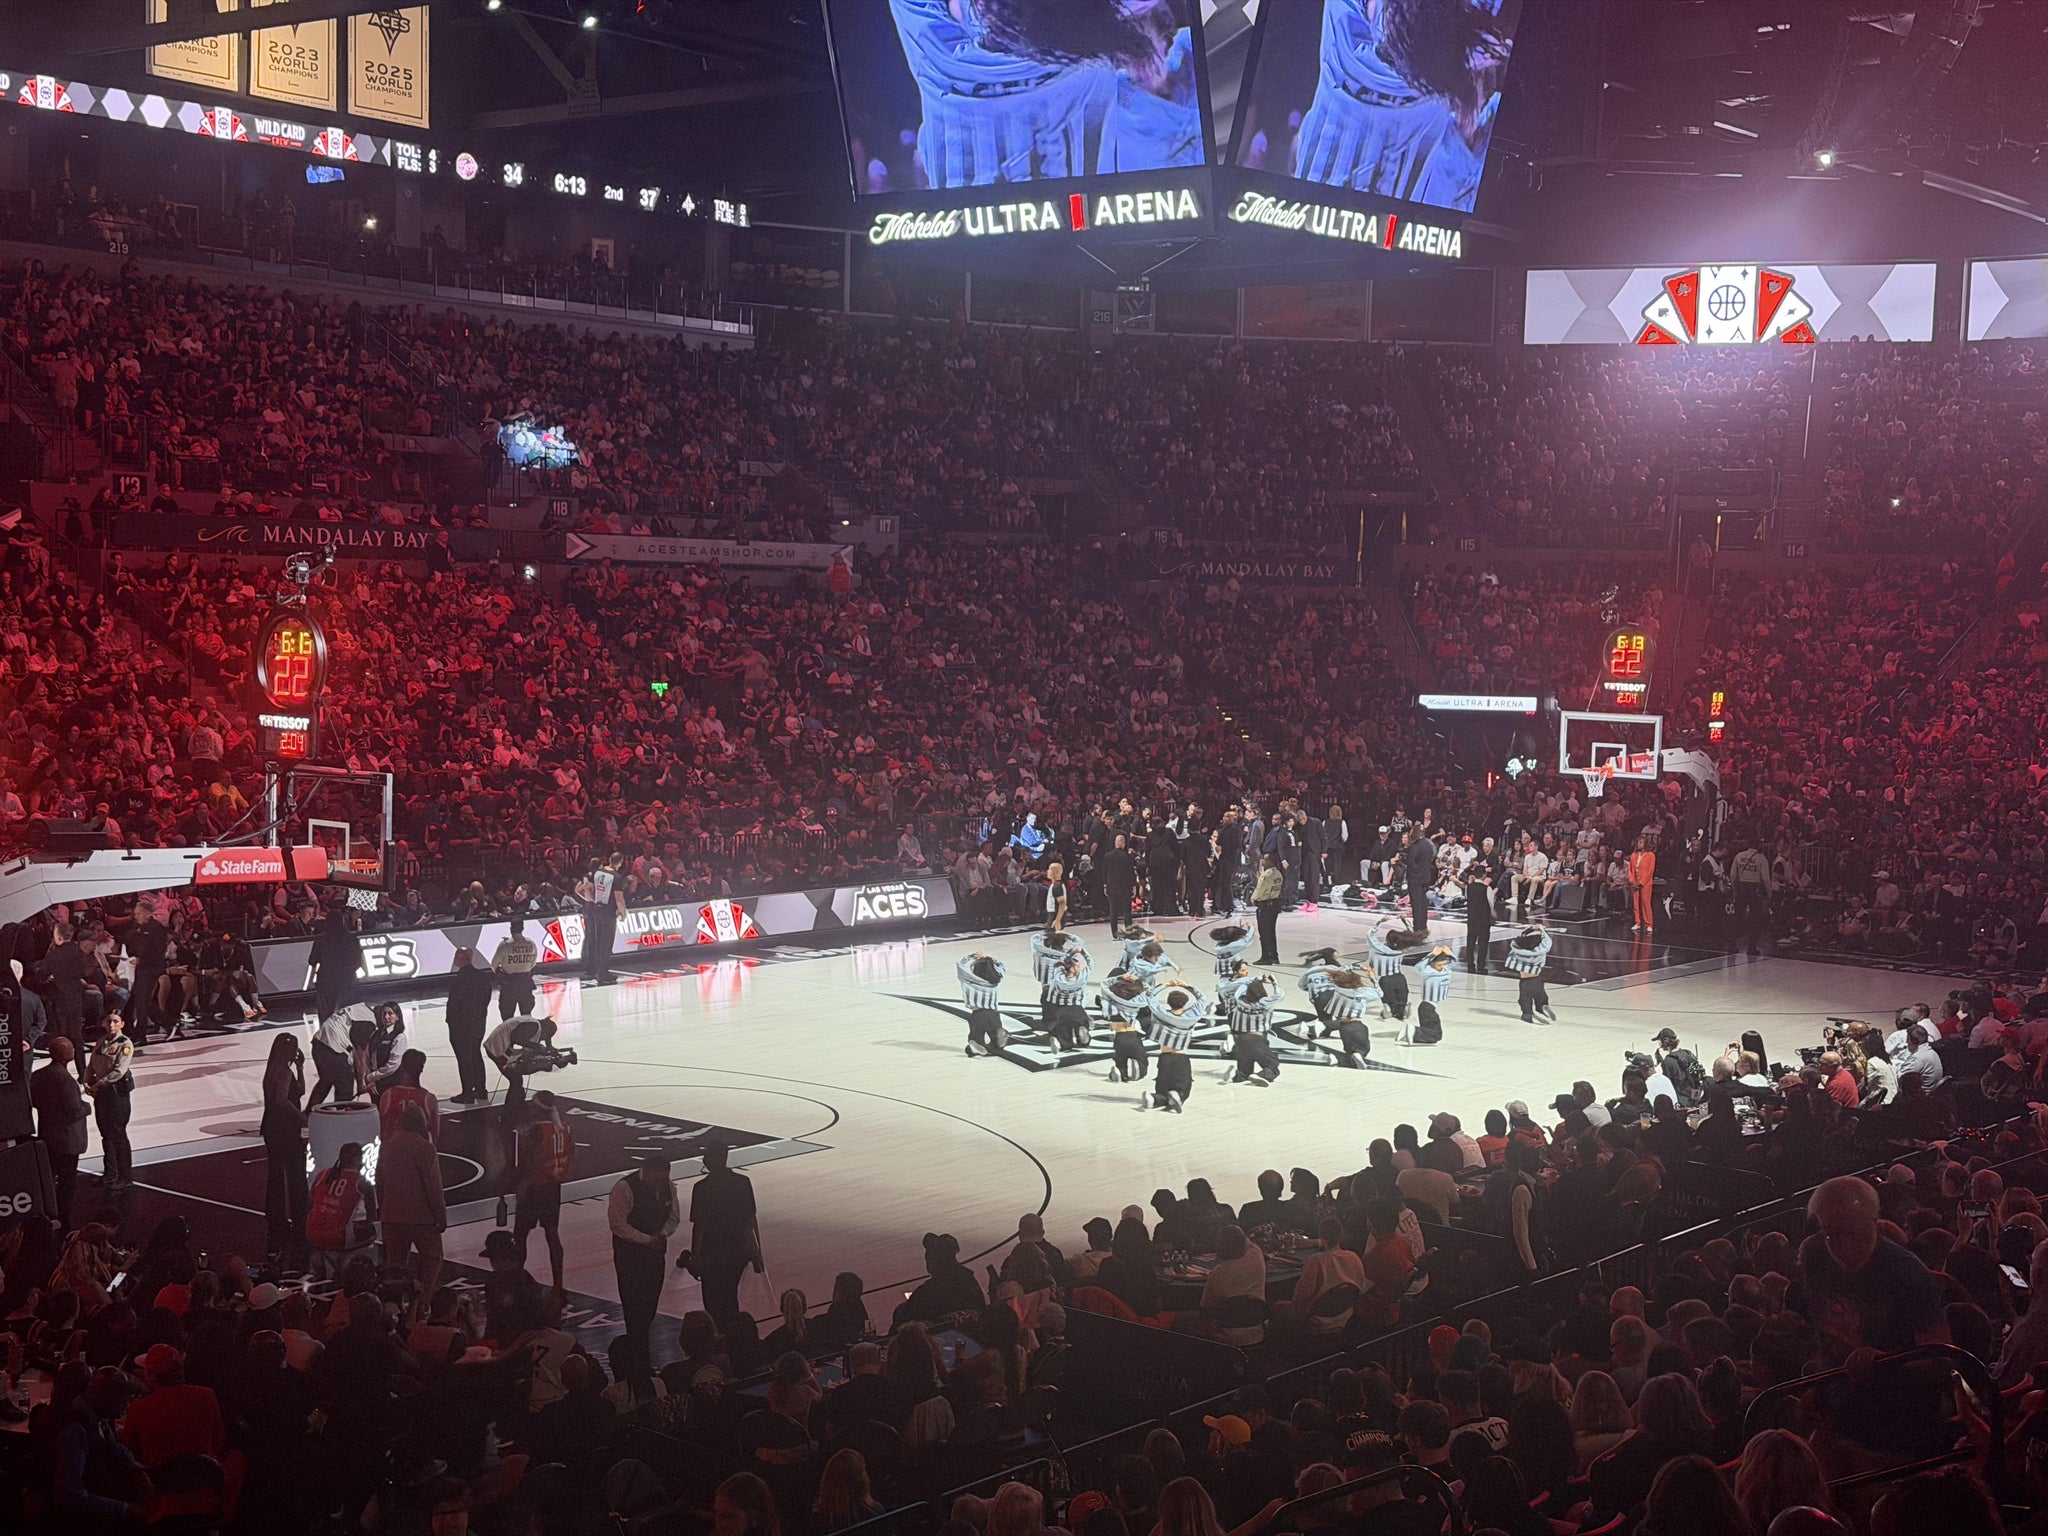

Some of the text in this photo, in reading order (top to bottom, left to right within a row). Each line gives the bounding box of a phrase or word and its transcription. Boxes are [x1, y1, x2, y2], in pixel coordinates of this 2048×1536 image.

[370, 14, 410, 33] ACES
[269, 41, 319, 61] 2023
[269, 54, 319, 71] WORLD
[365, 61, 413, 80] 2025
[269, 65, 319, 79] CHAMPIONS
[365, 73, 413, 90] WORLD
[365, 84, 413, 98] CHAMPIONS
[254, 118, 305, 141] WILD CARD
[395, 143, 437, 161] TOL: 4
[397, 157, 437, 173] FLS: 3
[503, 164, 523, 185] 34
[555, 174, 586, 196] 6:13
[604, 186, 623, 201] 2nd
[640, 189, 658, 208] 37
[870, 189, 1197, 244] Michelob ULTRA ARENA
[1235, 192, 1461, 259] Michelob ULTRA ARENA
[109, 241, 129, 254] 219
[553, 500, 569, 517] 118
[880, 519, 891, 532] 117
[263, 525, 429, 549] MANDALAY BAY
[637, 544, 796, 559] ACESTEAMSHOP.COM
[1201, 562, 1335, 578] MANDALAY BAY
[1617, 635, 1644, 650] 6:13
[1611, 649, 1641, 674] 22
[275, 655, 309, 697] 22
[1453, 699, 1483, 707] ULTRA
[1493, 700, 1523, 708] ARENA
[273, 716, 310, 730] TISSOT
[281, 733, 304, 751] 2:04
[866, 884, 905, 894] LAS VEGAS
[857, 891, 925, 920] ACES
[650, 908, 683, 931] CARD
[360, 937, 387, 947] EGAS
